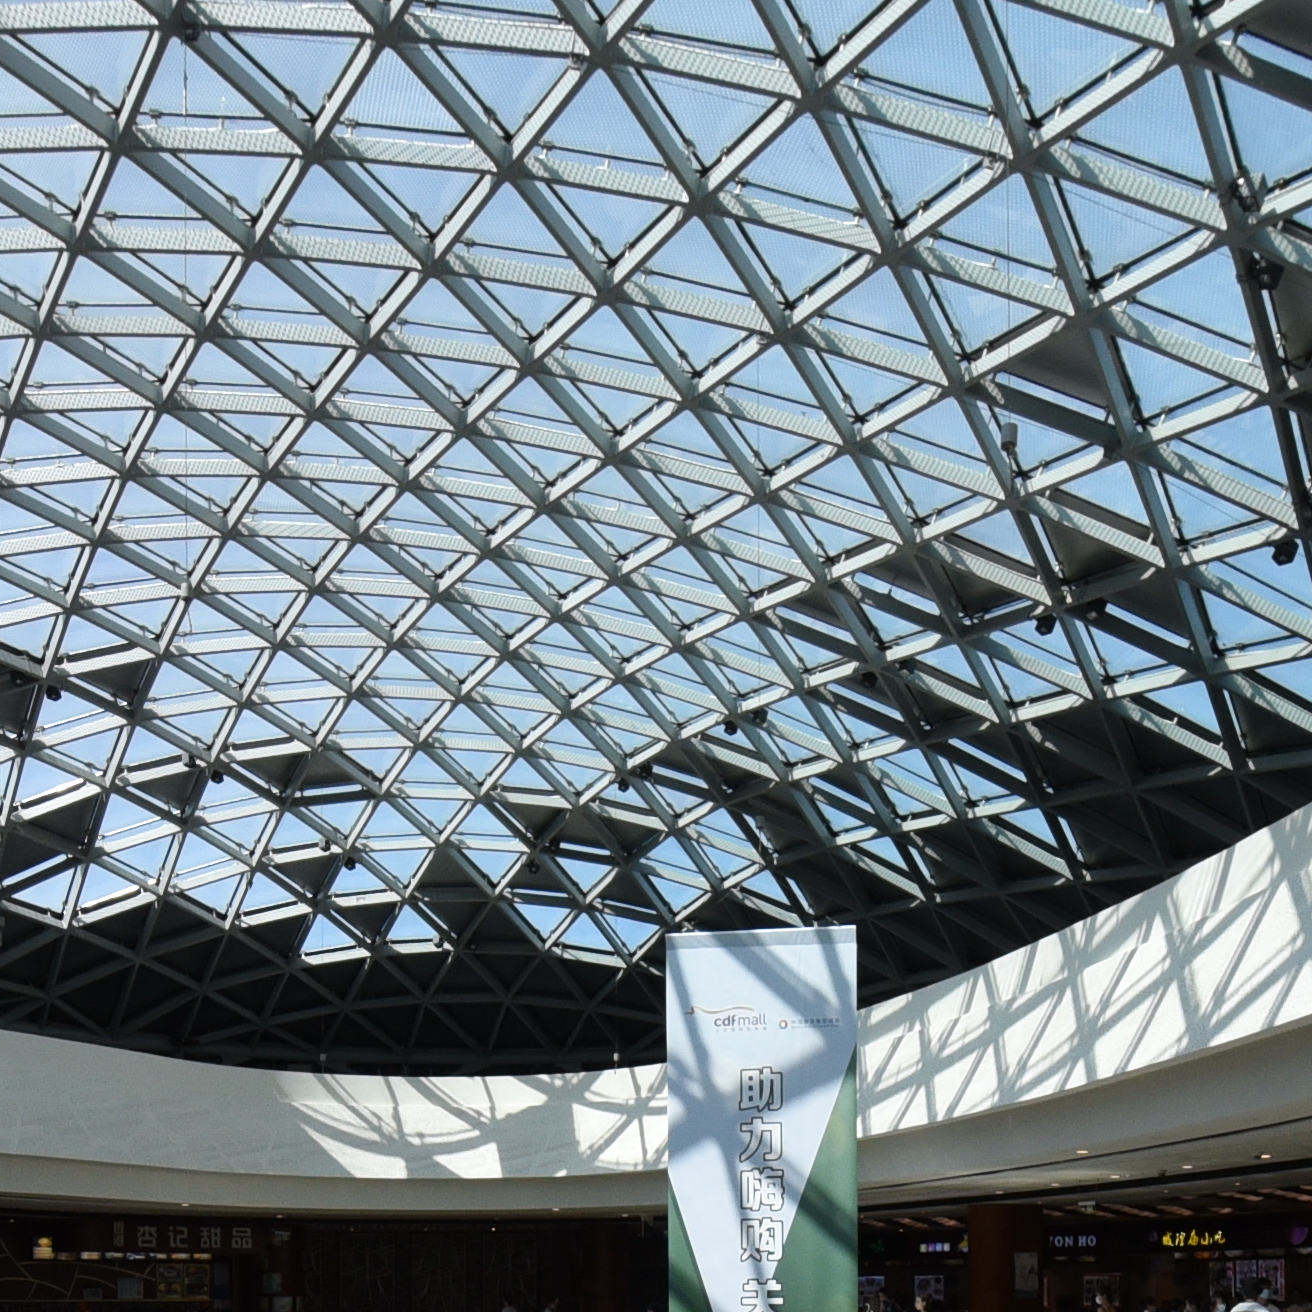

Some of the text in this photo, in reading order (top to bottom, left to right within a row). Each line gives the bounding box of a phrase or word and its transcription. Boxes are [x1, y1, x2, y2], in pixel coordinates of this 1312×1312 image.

[714, 1013, 767, 1027] cdfmall
[738, 1066, 786, 1263] 助力嗨购
[136, 1225, 253, 1249] 杏记甜品
[1049, 1234, 1074, 1248] ON
